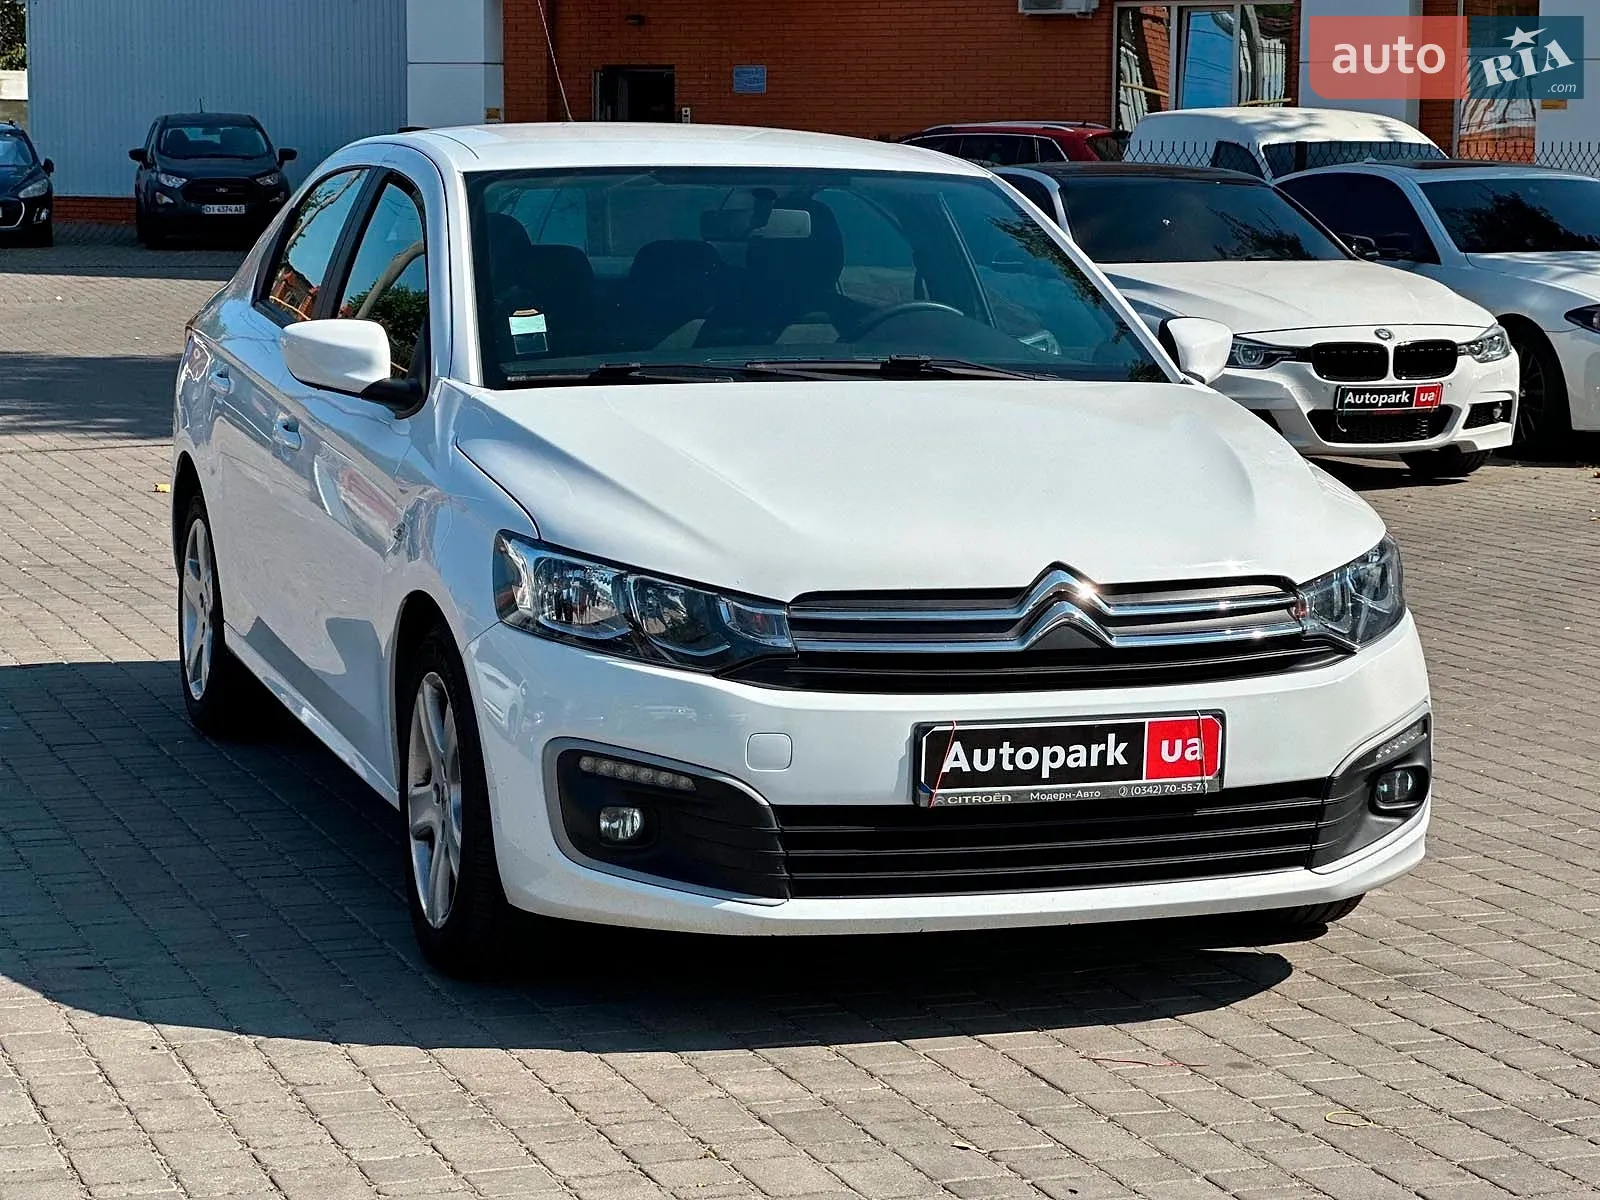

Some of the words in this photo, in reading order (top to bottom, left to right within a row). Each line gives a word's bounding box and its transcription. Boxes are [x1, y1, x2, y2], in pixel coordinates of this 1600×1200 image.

[1344, 390, 1410, 407] Autopark
[1419, 391, 1435, 402] ua
[942, 733, 1129, 778] Autopark
[1160, 736, 1204, 763] ua
[1030, 789, 1101, 802] Модерн-Авто
[1130, 784, 1162, 797] (0342)
